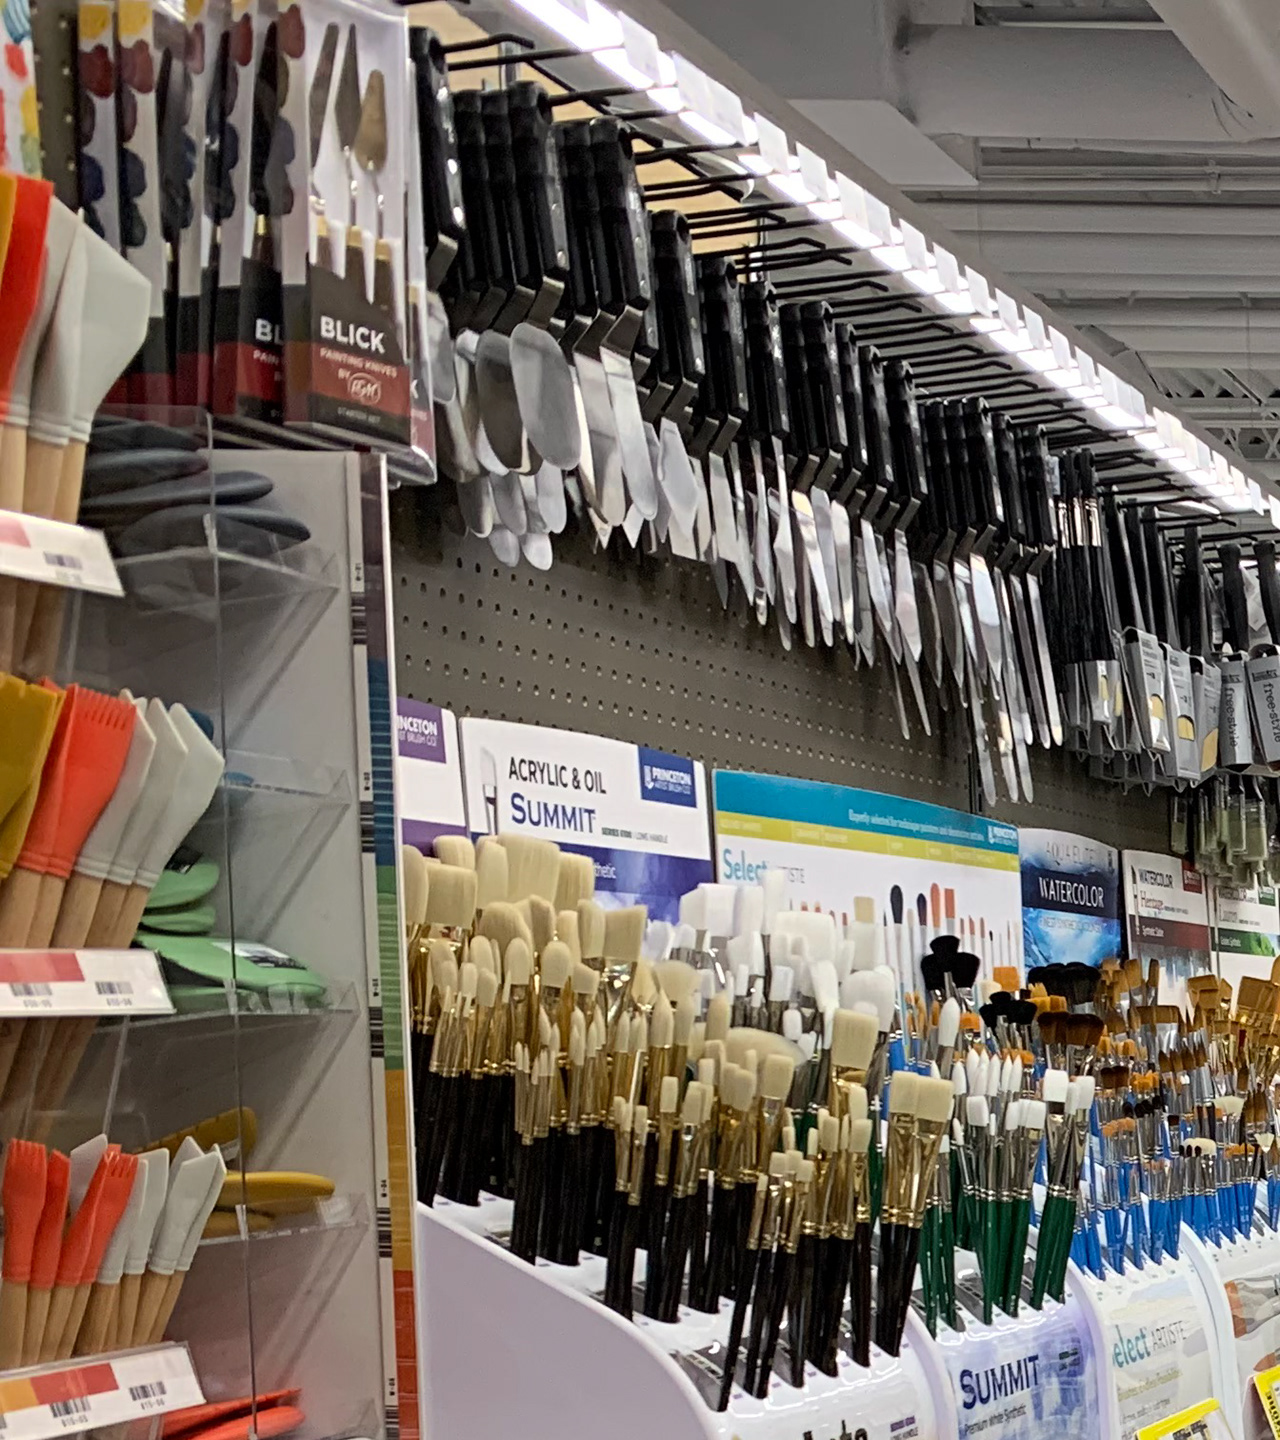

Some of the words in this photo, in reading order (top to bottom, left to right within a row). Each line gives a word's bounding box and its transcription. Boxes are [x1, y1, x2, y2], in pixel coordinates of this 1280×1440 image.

[320, 315, 386, 354] BLICK
[320, 347, 364, 369] PAINTING
[365, 357, 398, 379] KNIVES
[508, 756, 568, 788] ACRYLIC
[571, 770, 582, 790] &
[584, 772, 607, 795] OIL
[510, 792, 597, 834] SUMMIT
[594, 862, 617, 880] thetic
[722, 849, 768, 882] Select
[1138, 868, 1174, 890] WATERCOLOR
[1038, 877, 1104, 909] WATERCOLOR
[1150, 1320, 1187, 1351] ARTISTE
[959, 1354, 1040, 1410] SUMMIT
